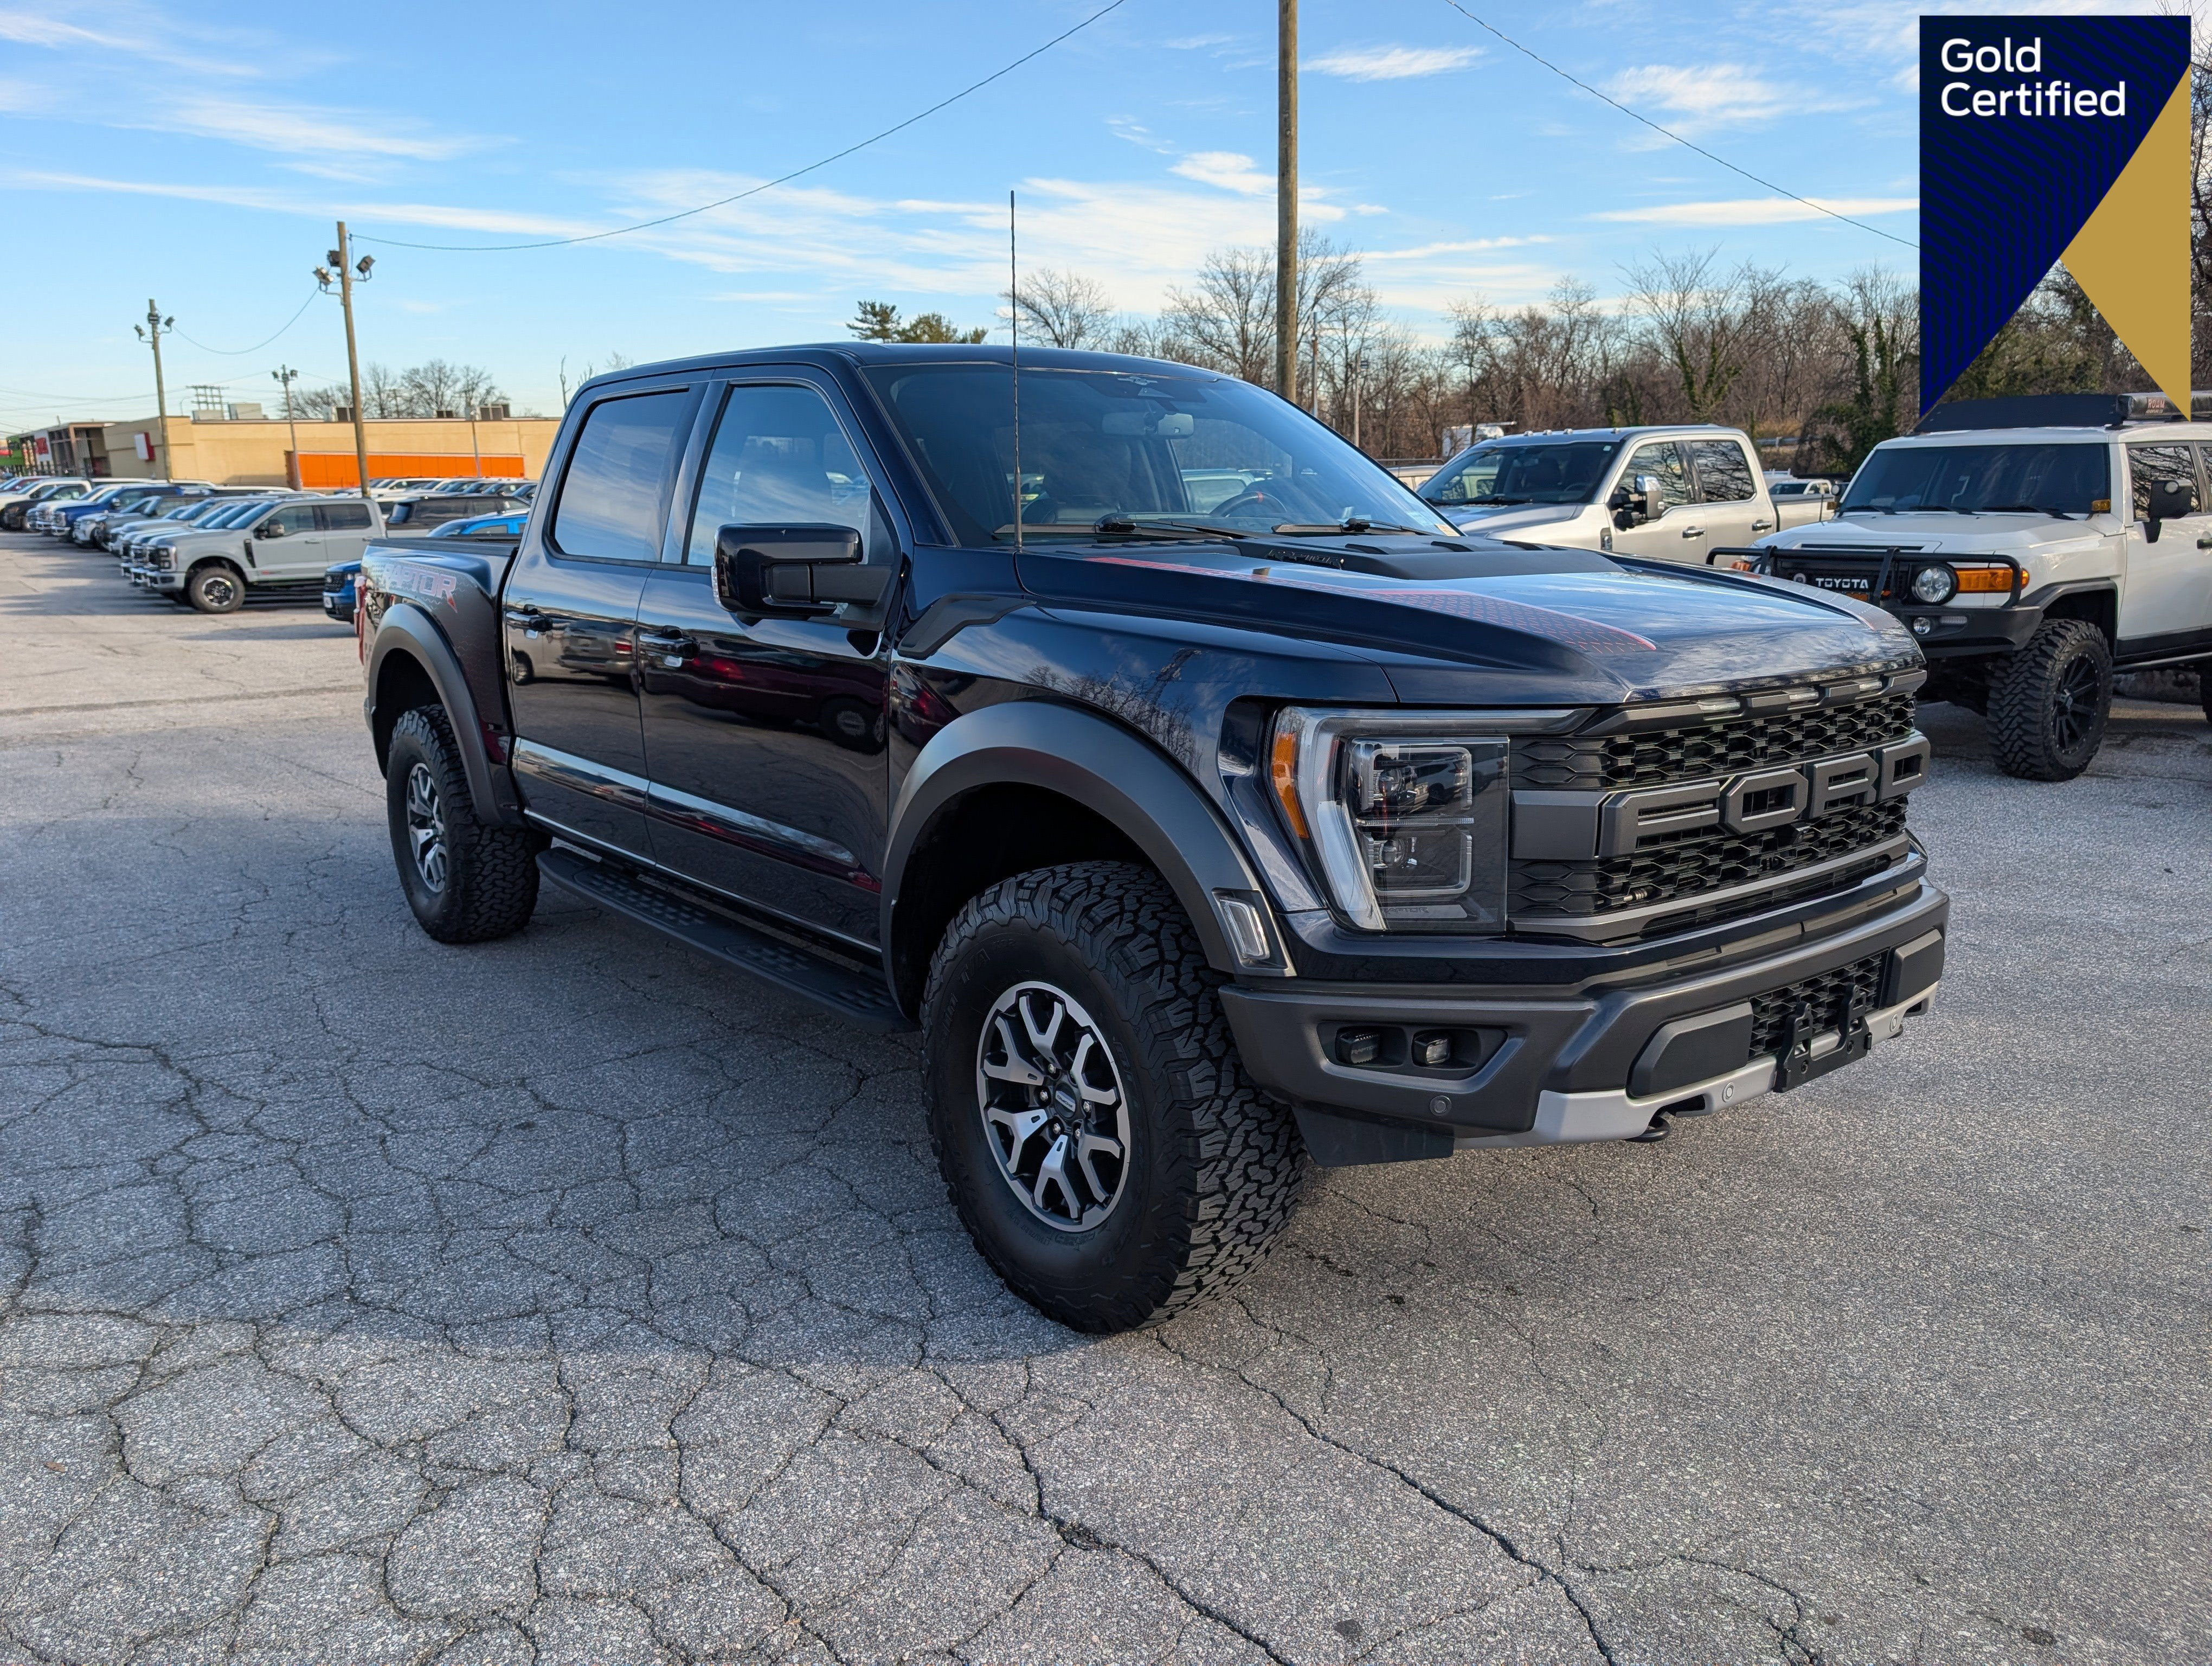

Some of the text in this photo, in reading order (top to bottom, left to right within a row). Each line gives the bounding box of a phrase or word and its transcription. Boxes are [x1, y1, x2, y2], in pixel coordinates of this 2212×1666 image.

[2147, 399, 2165, 408] ROAM
[1266, 549, 1345, 570] RAPTOR
[381, 563, 458, 613] RAPTOR
[1816, 578, 1869, 589] TOYOTA
[1599, 728, 1931, 860] FORD
